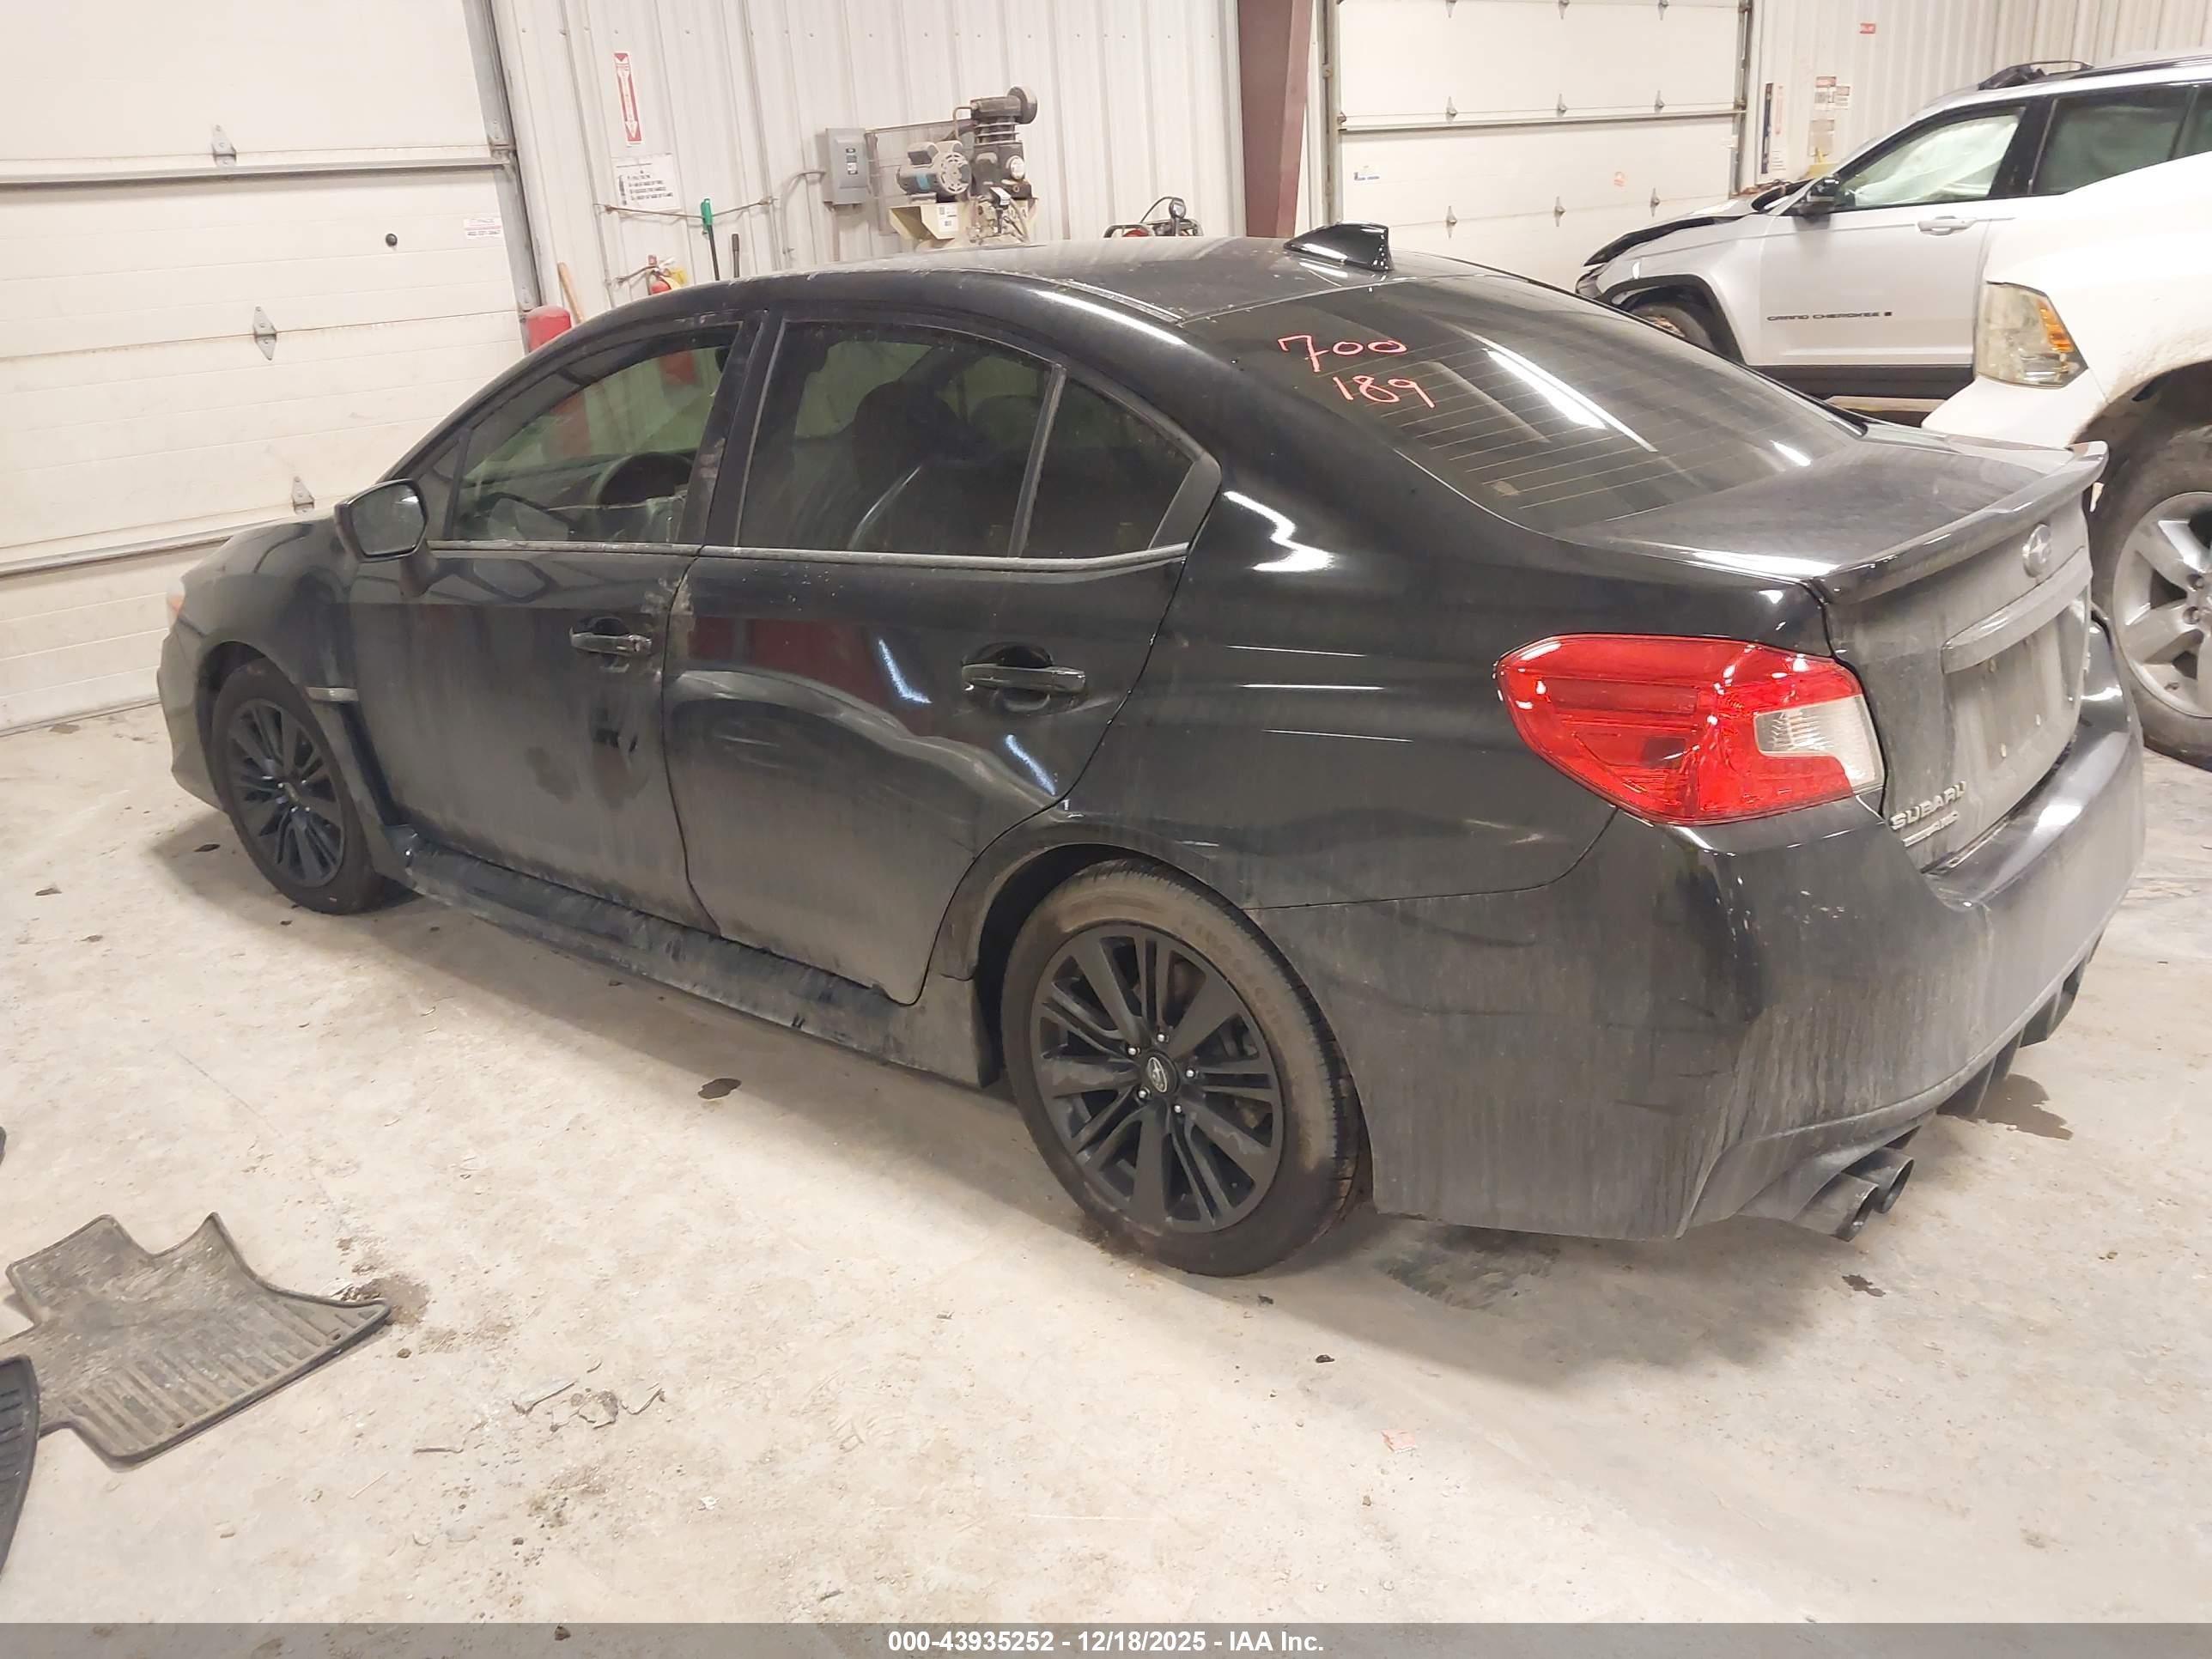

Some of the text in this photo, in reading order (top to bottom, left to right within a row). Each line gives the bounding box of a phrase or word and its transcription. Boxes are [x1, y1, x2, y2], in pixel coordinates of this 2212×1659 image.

[1277, 334, 1408, 373] 700
[1332, 374, 1436, 409] 189
[1890, 781, 1966, 830] SUBARU
